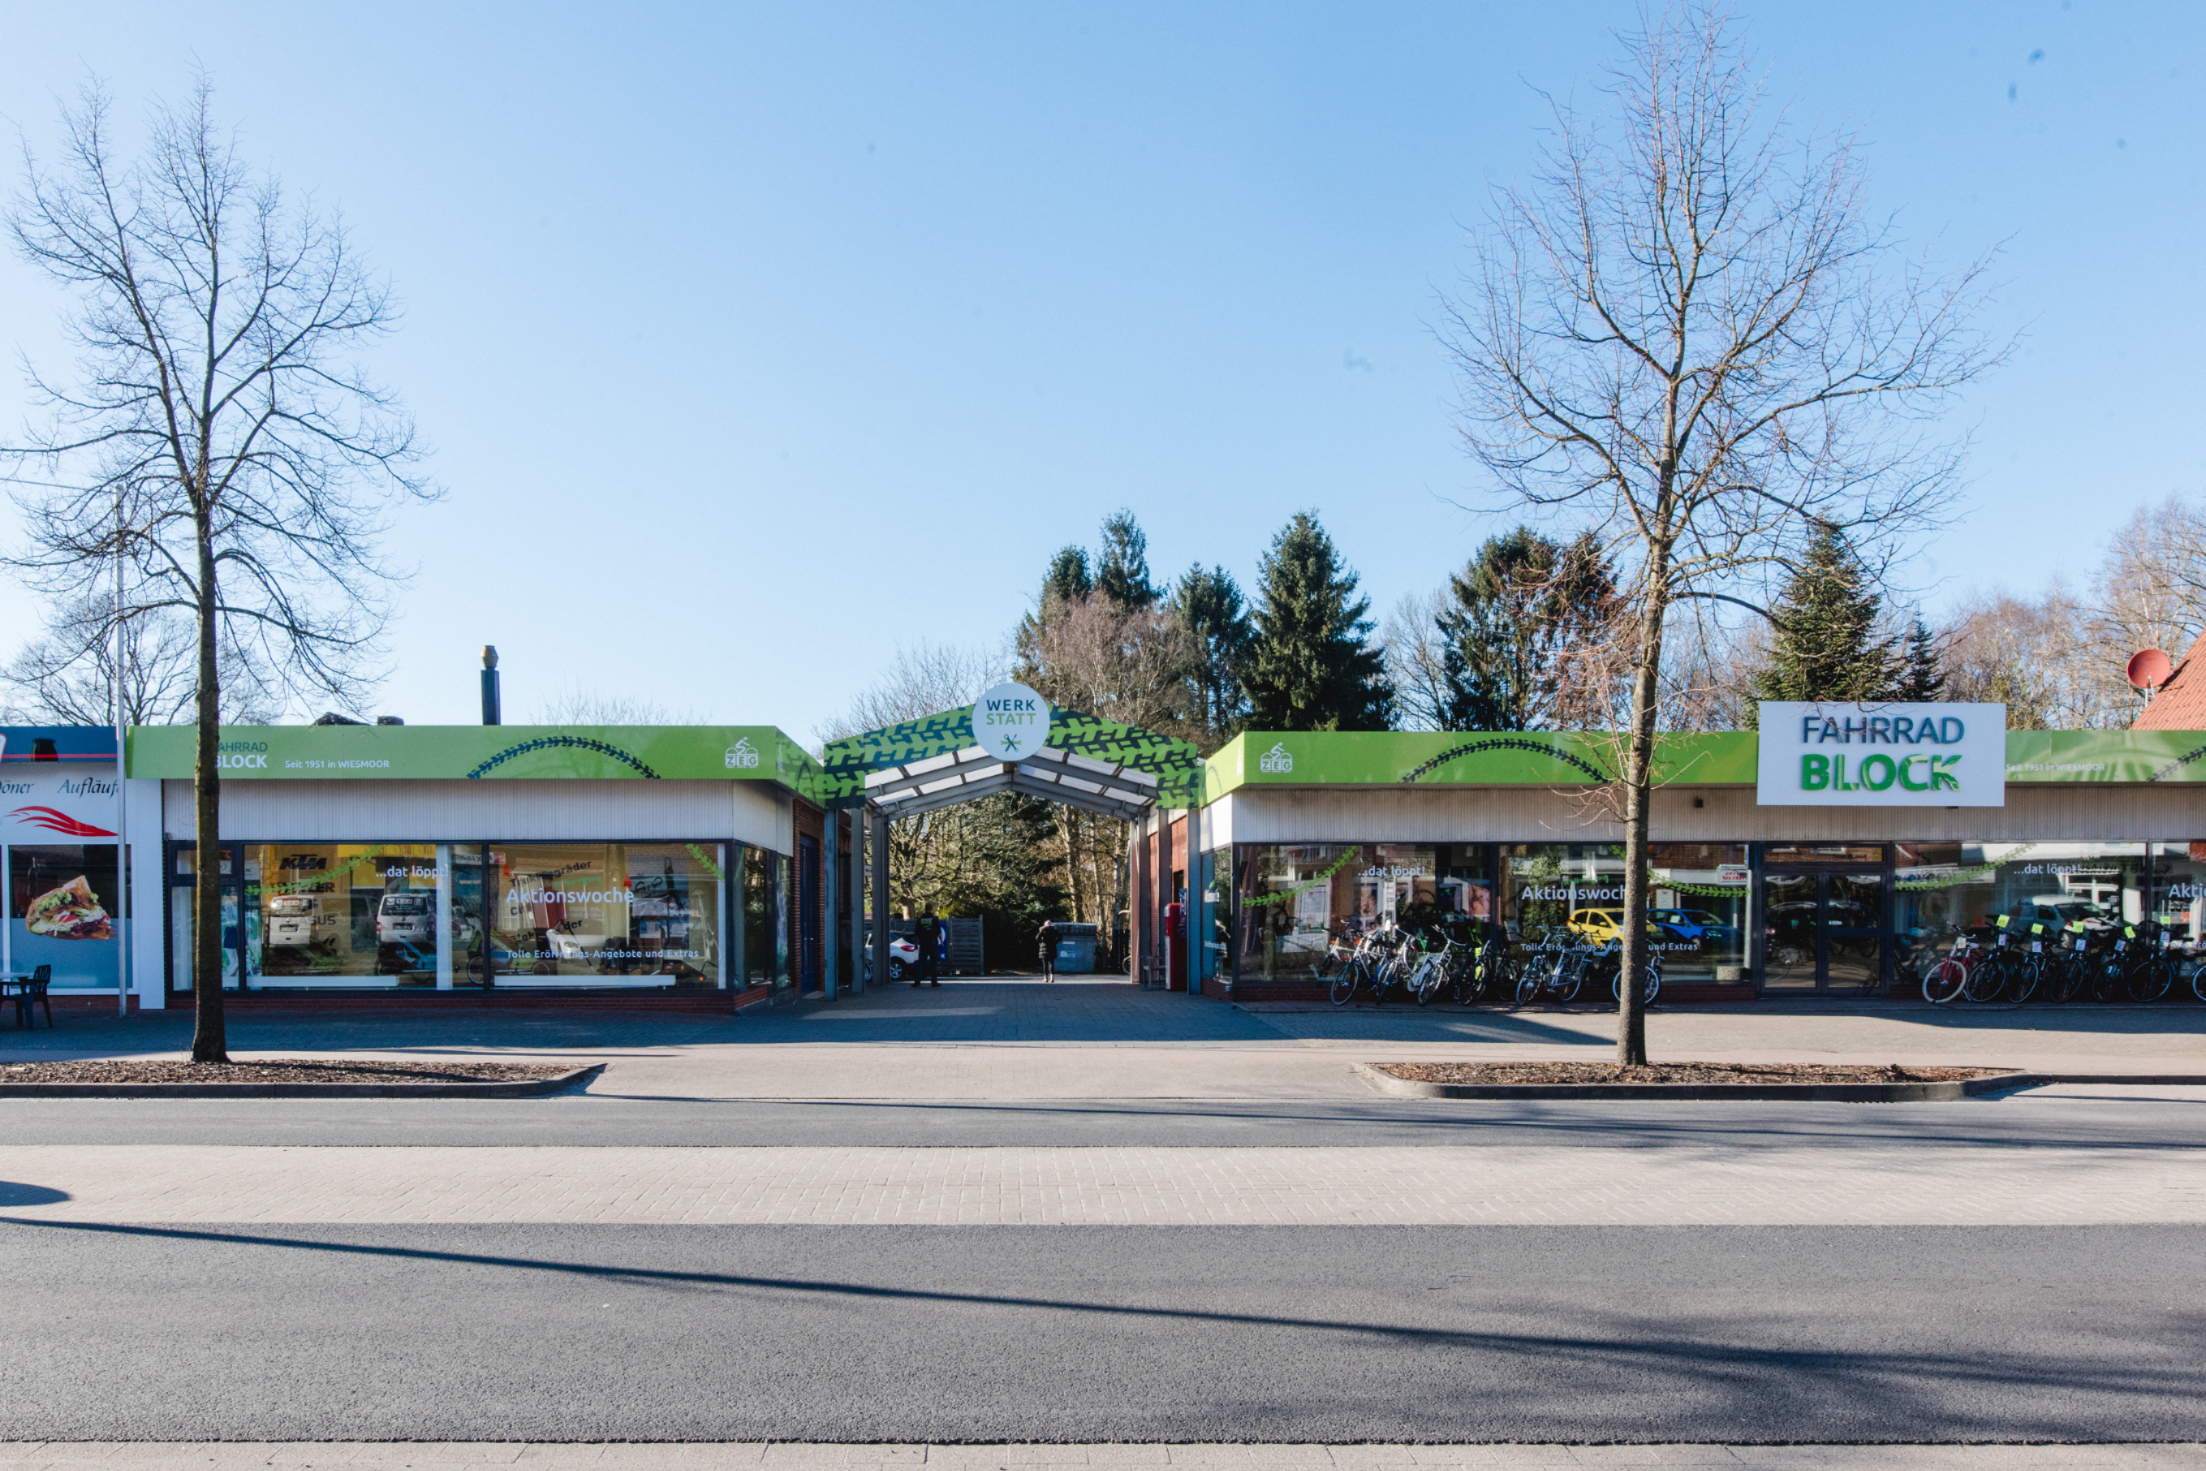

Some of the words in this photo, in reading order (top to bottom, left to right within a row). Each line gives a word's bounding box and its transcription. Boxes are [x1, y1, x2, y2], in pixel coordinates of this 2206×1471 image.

[986, 699, 1036, 711] WERK
[986, 712, 1036, 725] STATT
[1803, 716, 1965, 744] FAHRRAD
[217, 742, 268, 752] AHRRAD
[215, 754, 268, 768] BLOCK
[285, 760, 302, 768] Seit
[305, 760, 325, 768] 1951
[327, 760, 336, 768] in
[338, 760, 390, 768] WIESMOOR
[1261, 760, 1292, 770] ZEG
[1801, 753, 1963, 791] BLOCK
[0, 780, 34, 794] öner
[57, 777, 119, 798] Aufläuf
[279, 854, 327, 870] KTM
[505, 887, 635, 903] Aktionswoche
[1521, 885, 1626, 900] Aktionswoch
[2168, 883, 2206, 898] Akti
[1648, 942, 1665, 951] und
[1668, 942, 1698, 951] Extras
[507, 950, 529, 959] Tolle
[534, 949, 642, 960] Eröffnngs-Angebote
[645, 949, 664, 958] und
[667, 949, 699, 958] Extras
